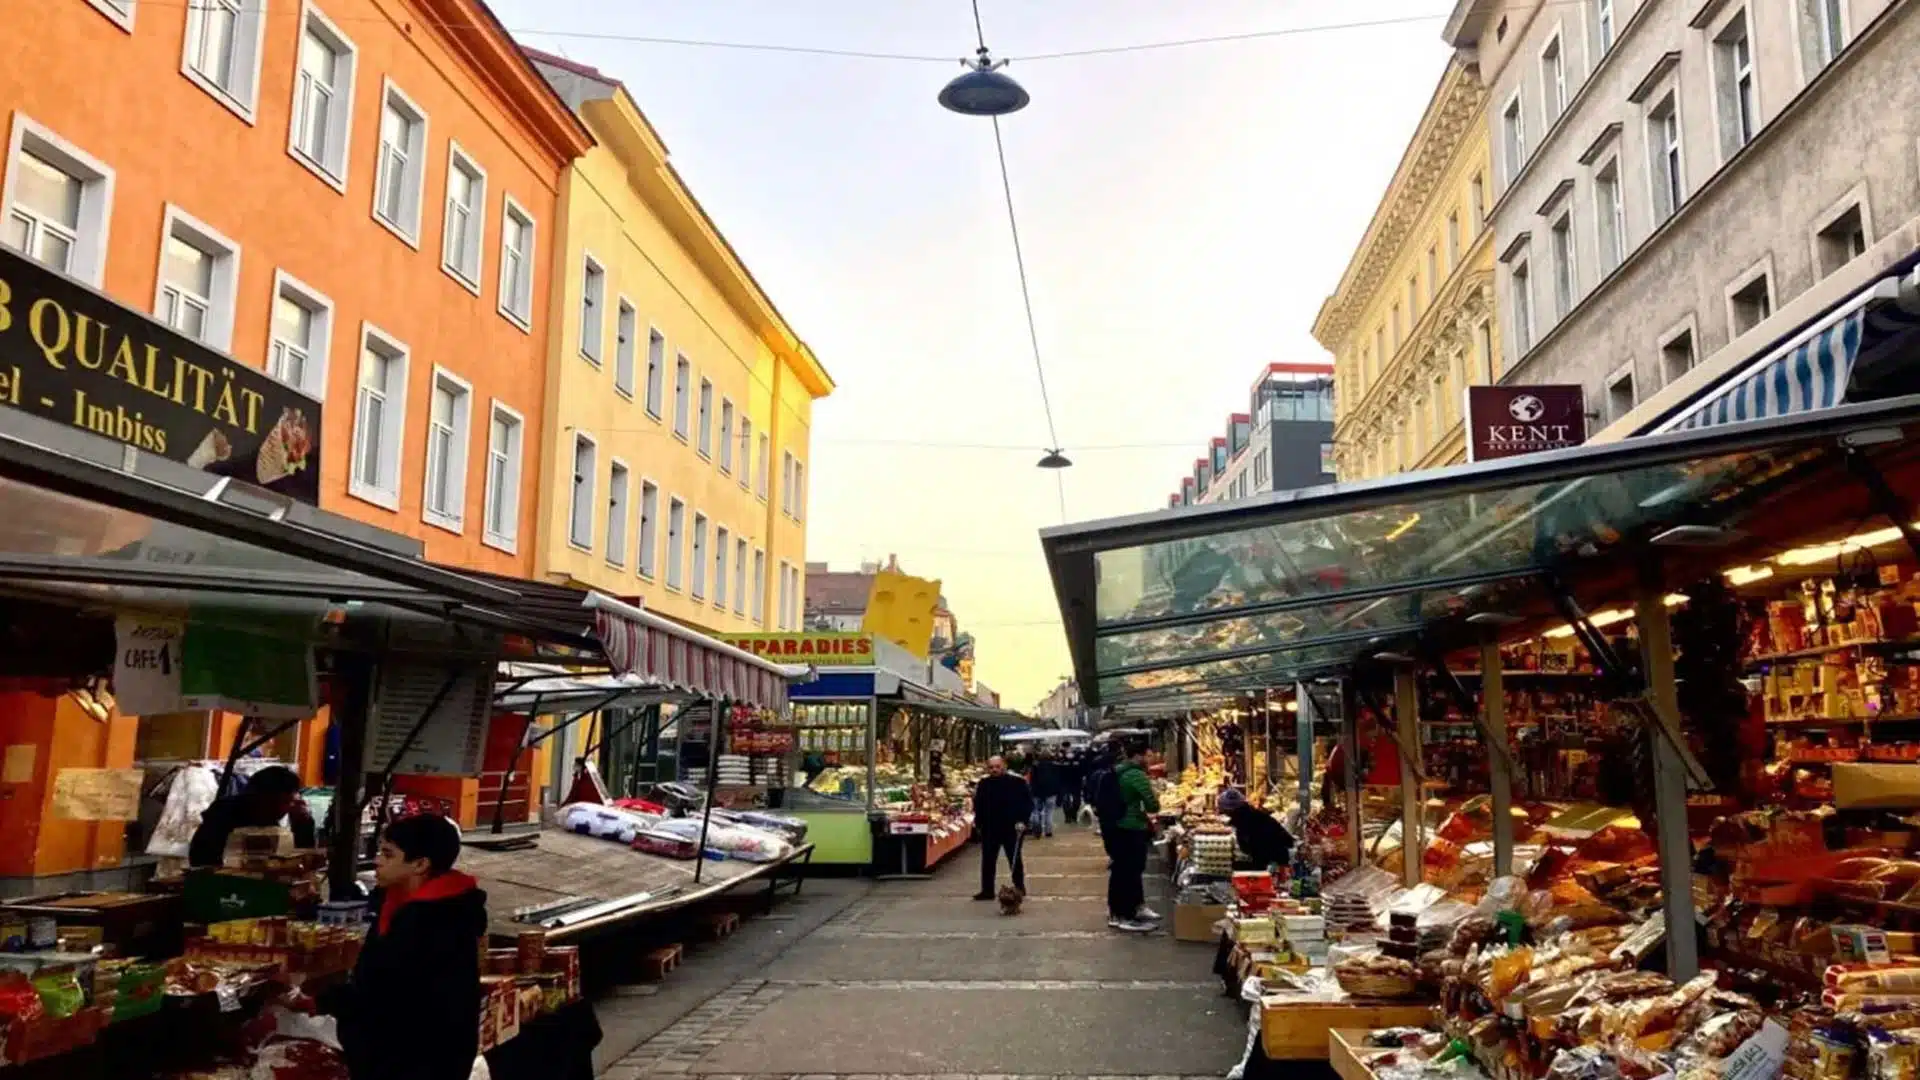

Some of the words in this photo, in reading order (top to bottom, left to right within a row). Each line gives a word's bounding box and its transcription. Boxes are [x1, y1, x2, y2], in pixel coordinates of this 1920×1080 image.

[29, 298, 265, 435] QUALITÄT
[73, 388, 168, 454] Imbiss
[1488, 425, 1569, 441] KENT
